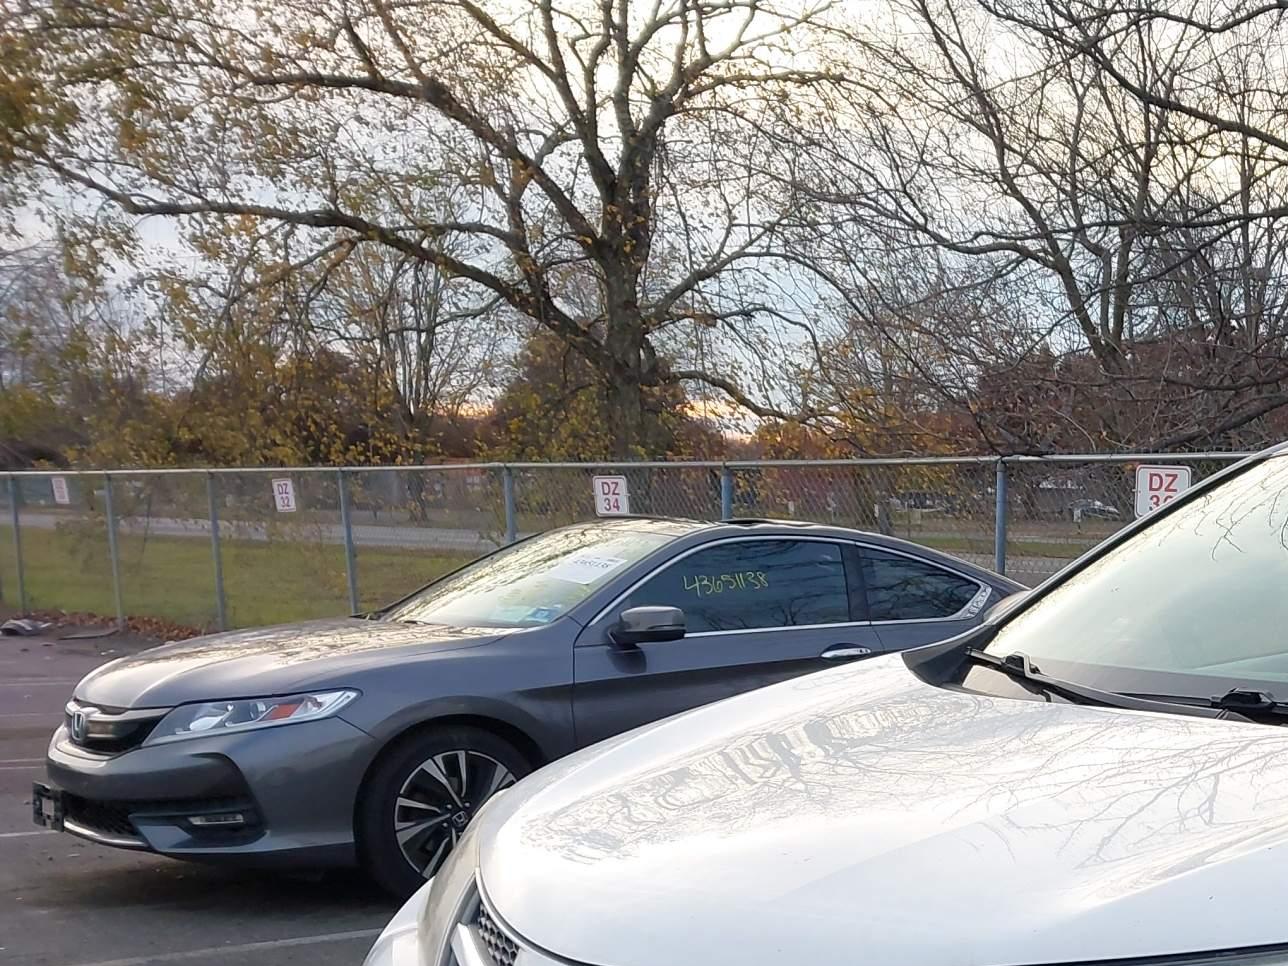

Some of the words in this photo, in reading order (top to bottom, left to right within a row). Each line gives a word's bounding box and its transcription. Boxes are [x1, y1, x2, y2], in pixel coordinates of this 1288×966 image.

[277, 483, 289, 495] DZ
[601, 481, 620, 496] DZ
[1149, 472, 1179, 493] DZ
[604, 497, 621, 512] 34
[1149, 495, 1175, 511] 3
[683, 571, 769, 597] 43651138
